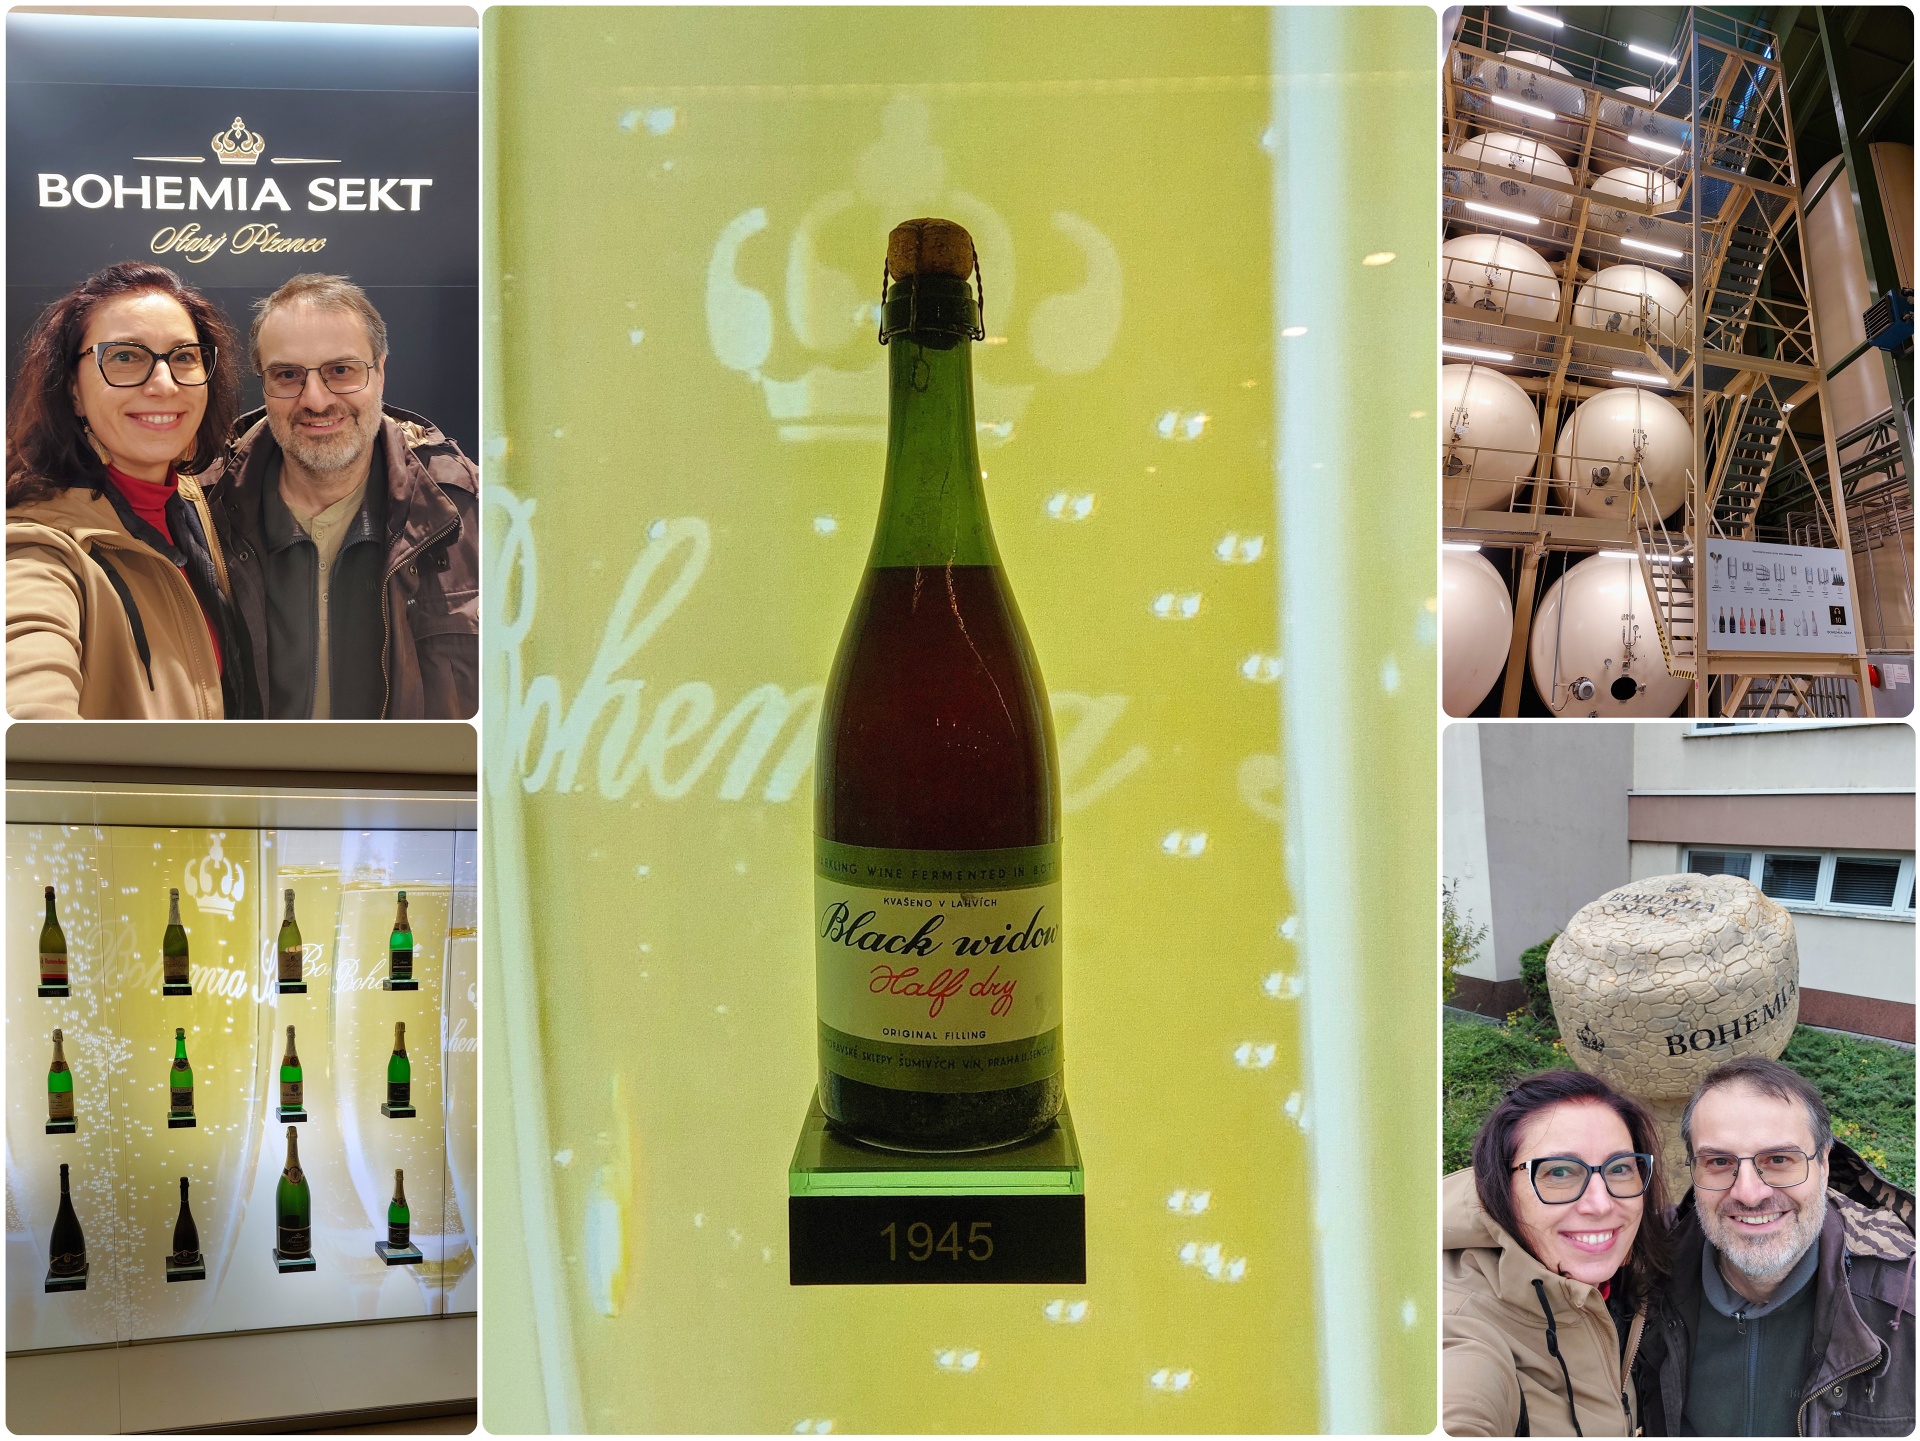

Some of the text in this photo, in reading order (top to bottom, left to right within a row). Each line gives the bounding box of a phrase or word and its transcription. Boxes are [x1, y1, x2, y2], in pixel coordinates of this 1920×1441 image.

[37, 173, 433, 212] BOHEMIA SEKT
[149, 222, 327, 264] Starý Plzenec
[867, 865, 902, 879] WINE
[911, 868, 1006, 881] FERMENTED
[1014, 864, 1025, 878] IN
[883, 896, 998, 908] KVAŠENO V LAHVÍCH
[820, 900, 1059, 957] Black widow
[868, 964, 1018, 1019] Half dry
[882, 1027, 986, 1040] ORIGINAL FILLING
[1664, 979, 1796, 1057] BOHEMIA
[862, 1051, 893, 1065] SKLEPY
[899, 1053, 955, 1070] ŠUMIVÝCH
[988, 1053, 1019, 1068] PRAHA
[880, 1221, 994, 1262] 1945
